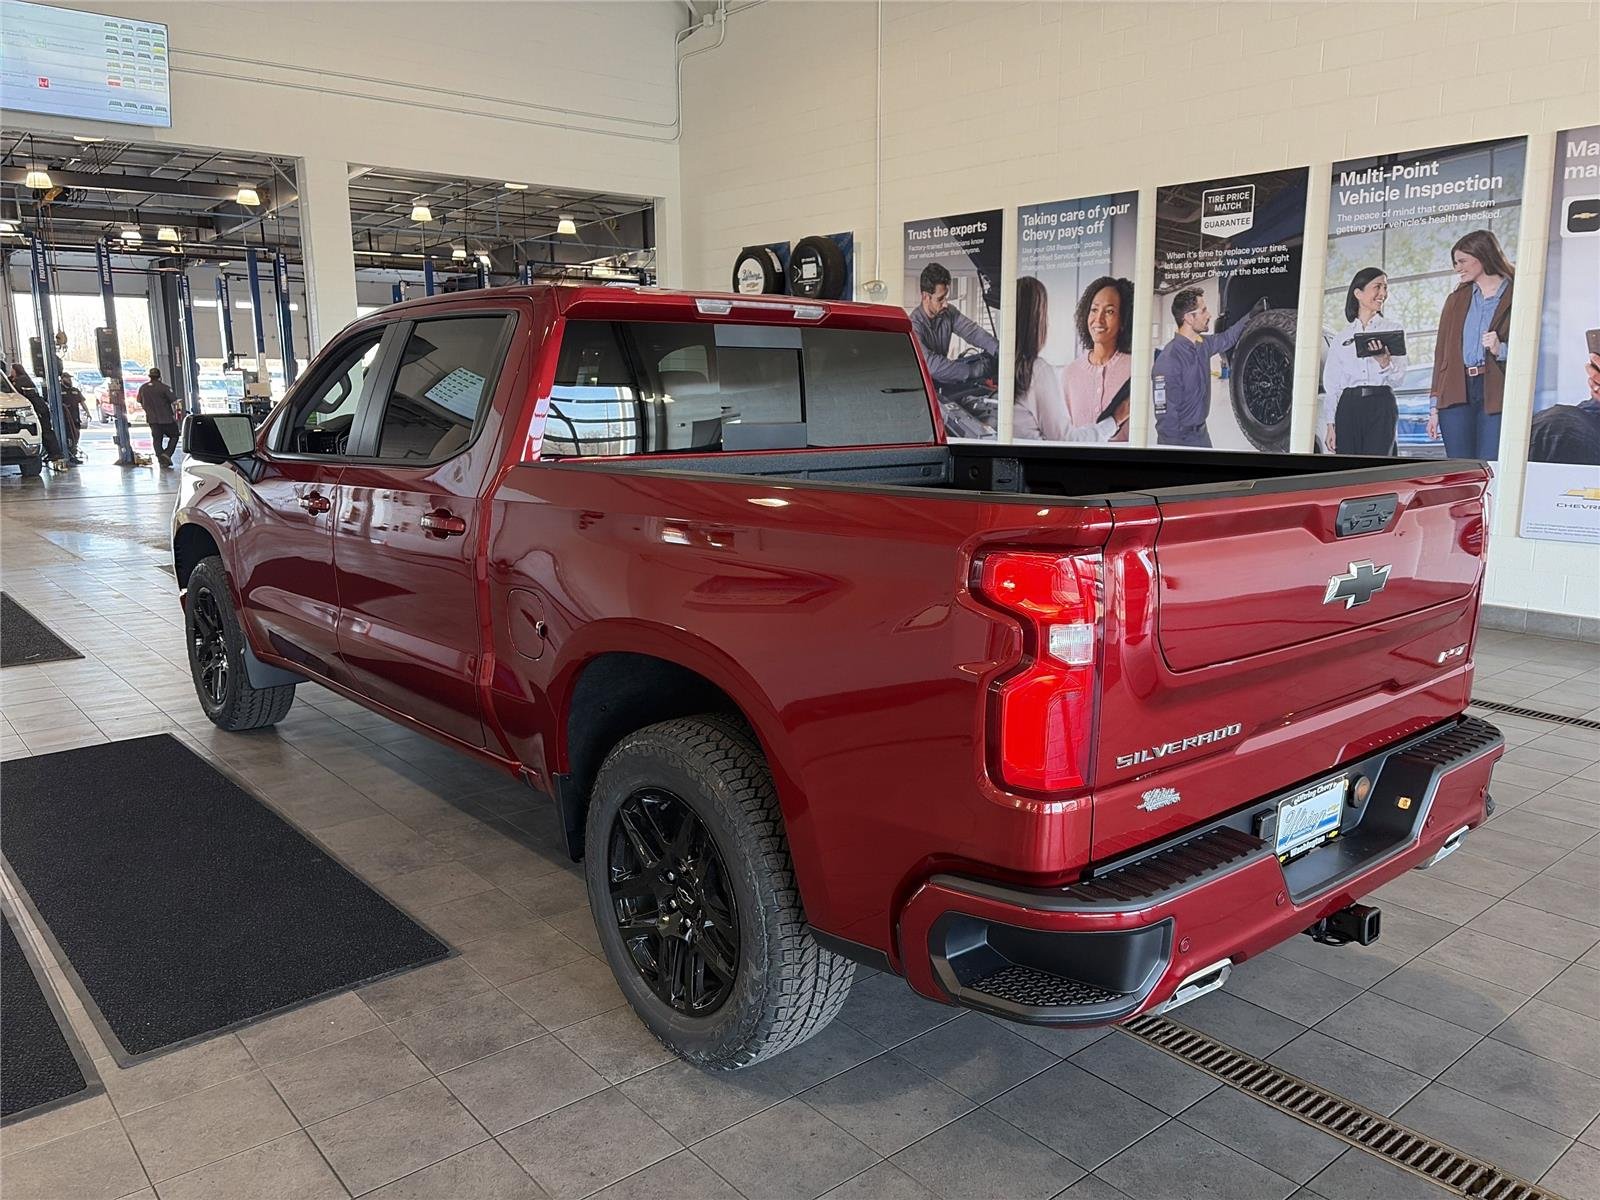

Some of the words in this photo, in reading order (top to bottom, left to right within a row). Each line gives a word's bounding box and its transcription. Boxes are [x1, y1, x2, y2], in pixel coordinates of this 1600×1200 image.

[1566, 140, 1600, 158] Ma
[1340, 161, 1439, 187] Multi-Point
[1564, 164, 1600, 180] ma
[1207, 195, 1225, 204] TIRE
[1226, 191, 1250, 201] PRICE
[1339, 186, 1400, 206] Vehicle
[1404, 174, 1503, 199] Inspection
[1022, 211, 1057, 226] Taking
[1060, 209, 1085, 222] care
[1087, 204, 1101, 219] of
[1102, 203, 1131, 219] your
[1214, 201, 1242, 212] MATCH
[1337, 213, 1352, 222] The
[1354, 211, 1380, 223] peace
[1381, 209, 1392, 218] of
[1393, 205, 1416, 217] mind
[1417, 204, 1436, 214] that
[1438, 202, 1470, 211] comes
[1471, 199, 1496, 209] from
[908, 228, 931, 240] Trust
[933, 225, 949, 238] the
[950, 221, 988, 237] experts
[1022, 228, 1055, 242] Chevy
[1058, 224, 1084, 240] pays
[1086, 220, 1105, 234] off
[1203, 217, 1251, 229] GUARANTEE
[1336, 222, 1366, 235] getting
[1367, 222, 1388, 232] your
[1389, 216, 1427, 229] vehicle's
[1428, 212, 1458, 224] health
[1459, 209, 1503, 222] checked.
[1166, 252, 1186, 260] When
[1186, 250, 1198, 259] it's
[1198, 249, 1214, 258] time
[1223, 246, 1250, 257] replace
[1251, 245, 1267, 256] your
[1269, 243, 1289, 253] tires,
[1163, 261, 1174, 270] let
[1183, 260, 1192, 269] do
[1193, 259, 1205, 268] the
[1206, 258, 1225, 267] work.
[1226, 257, 1238, 266] We
[1239, 256, 1256, 265] have
[1257, 255, 1270, 264] the
[1271, 253, 1290, 264] right
[1164, 271, 1180, 280] tires
[1180, 270, 1190, 279] for
[1191, 270, 1206, 281] your
[1207, 269, 1229, 280] Chevy
[1229, 268, 1238, 276] at
[1238, 266, 1251, 276] the
[1252, 266, 1269, 275] best
[1270, 264, 1289, 274] deal.
[1556, 502, 1600, 510] CHEVR
[1116, 722, 1242, 770] SILVERADO
